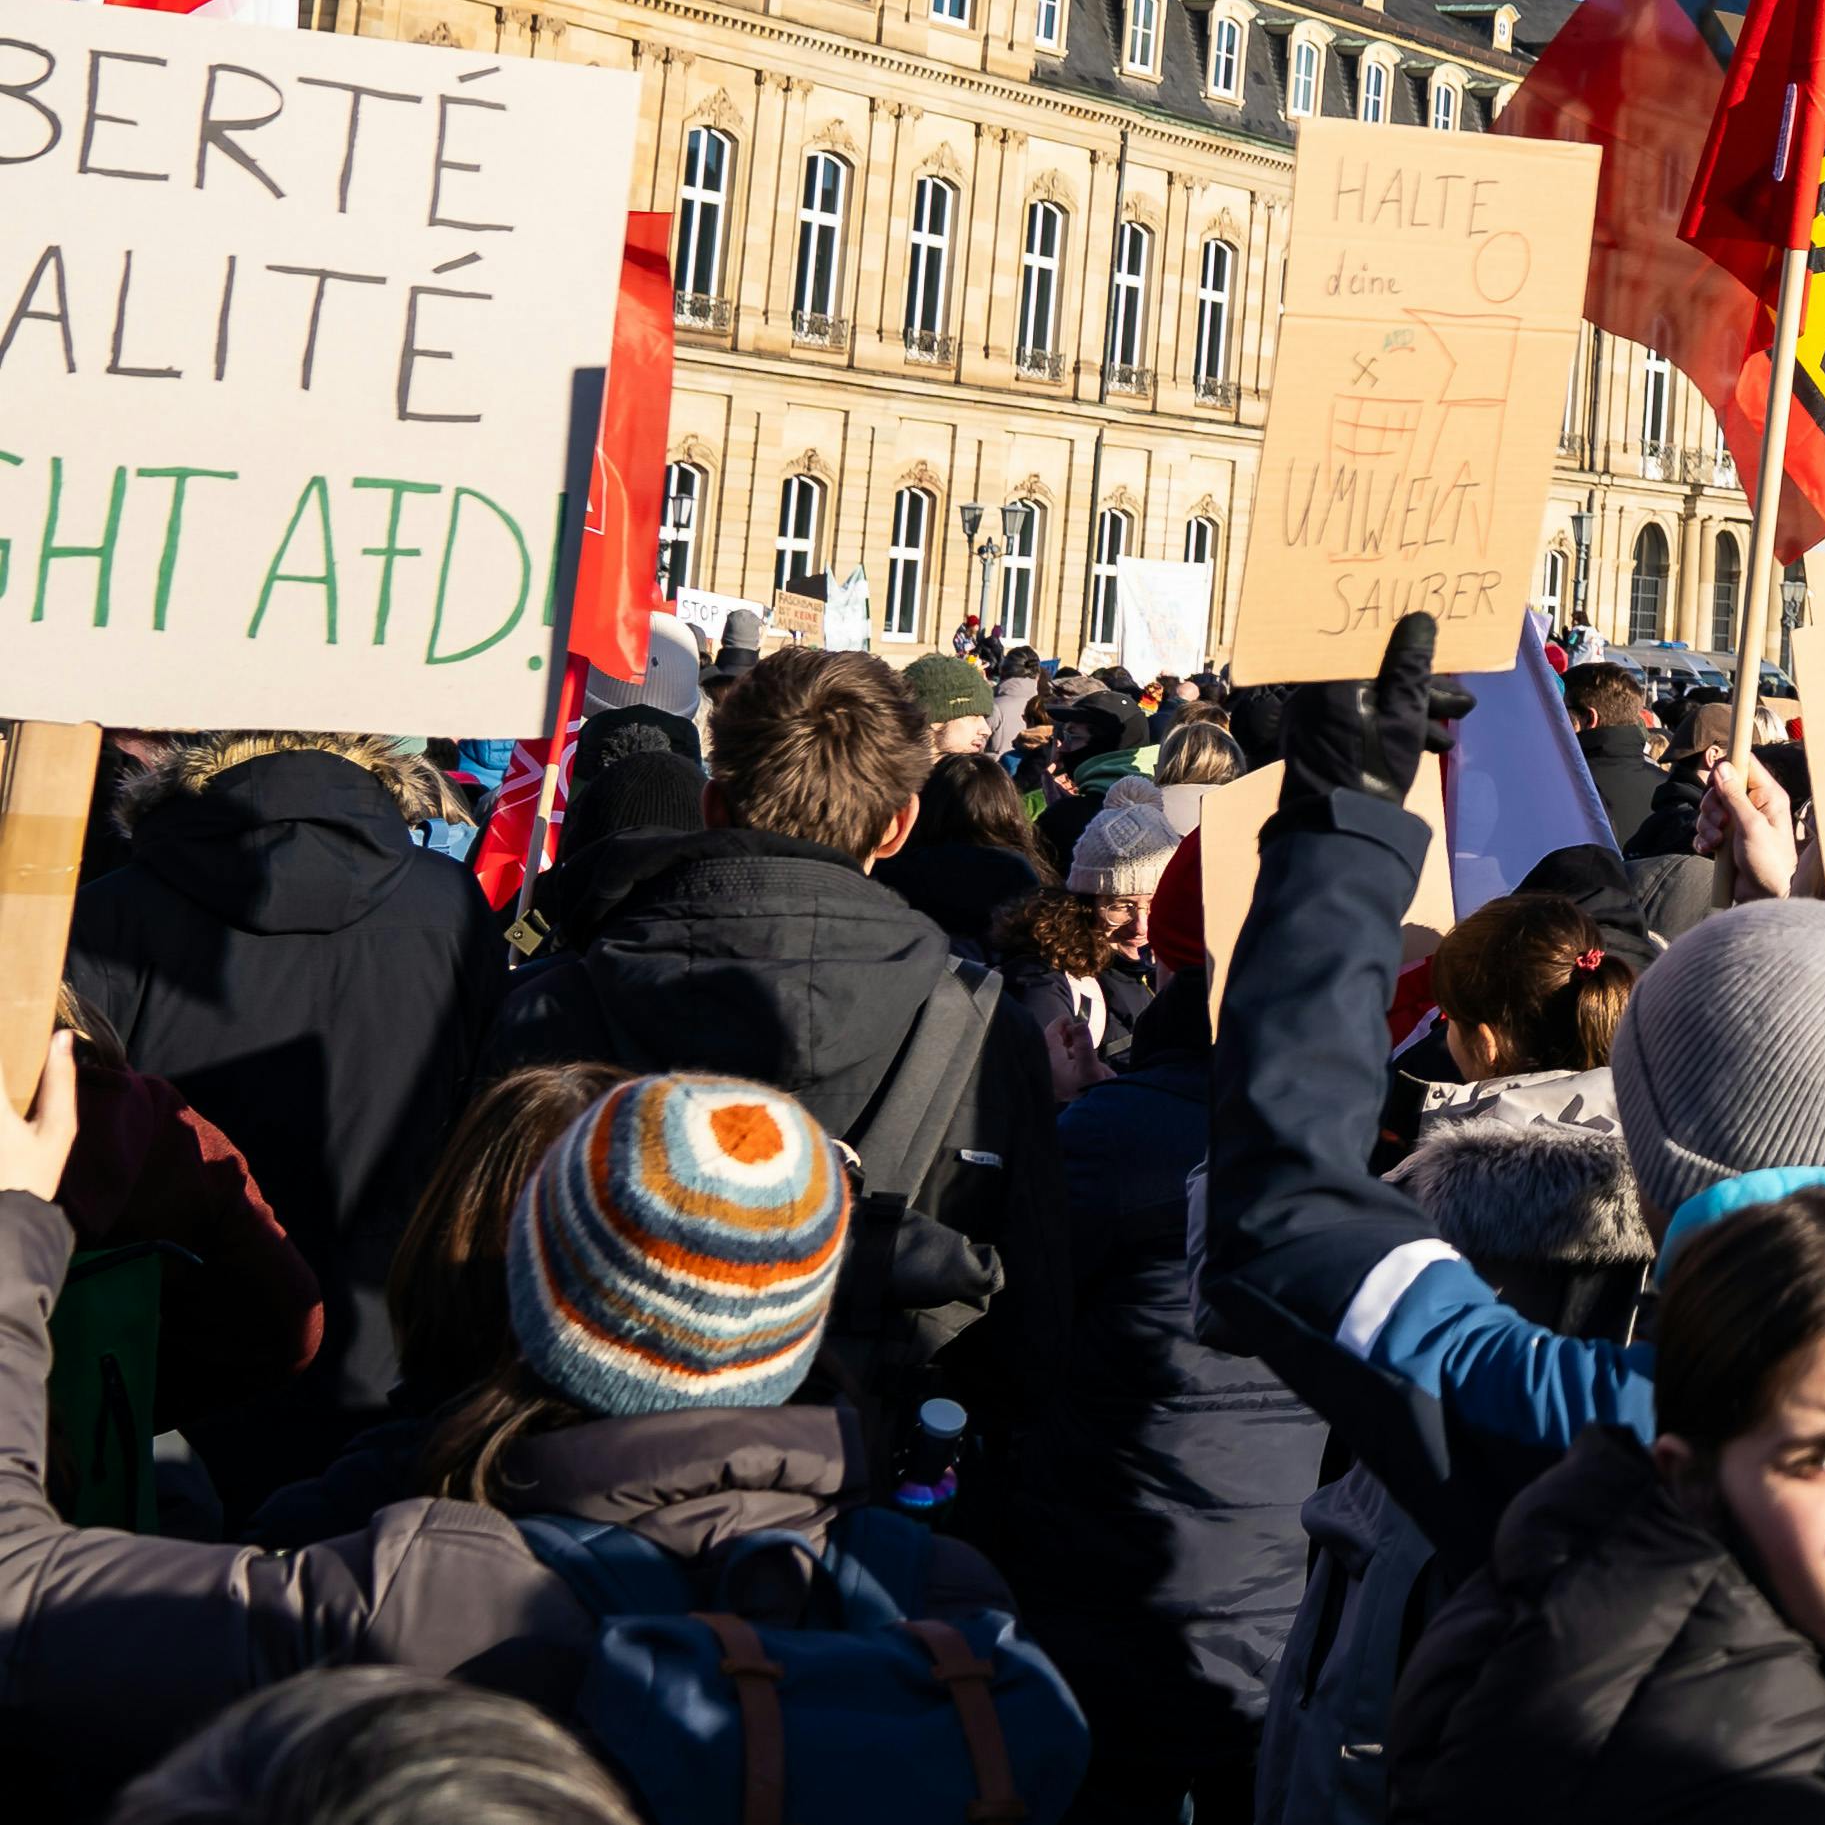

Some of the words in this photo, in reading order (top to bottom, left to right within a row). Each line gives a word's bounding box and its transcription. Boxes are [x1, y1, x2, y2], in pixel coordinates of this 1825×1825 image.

[1333, 155, 1502, 238] HALTE
[1326, 250, 1404, 297] deine
[0, 244, 493, 423] ALITÉ
[1283, 458, 1482, 555] UMWELT
[681, 599, 719, 623] STOP
[1317, 571, 1502, 637] SAUBER
